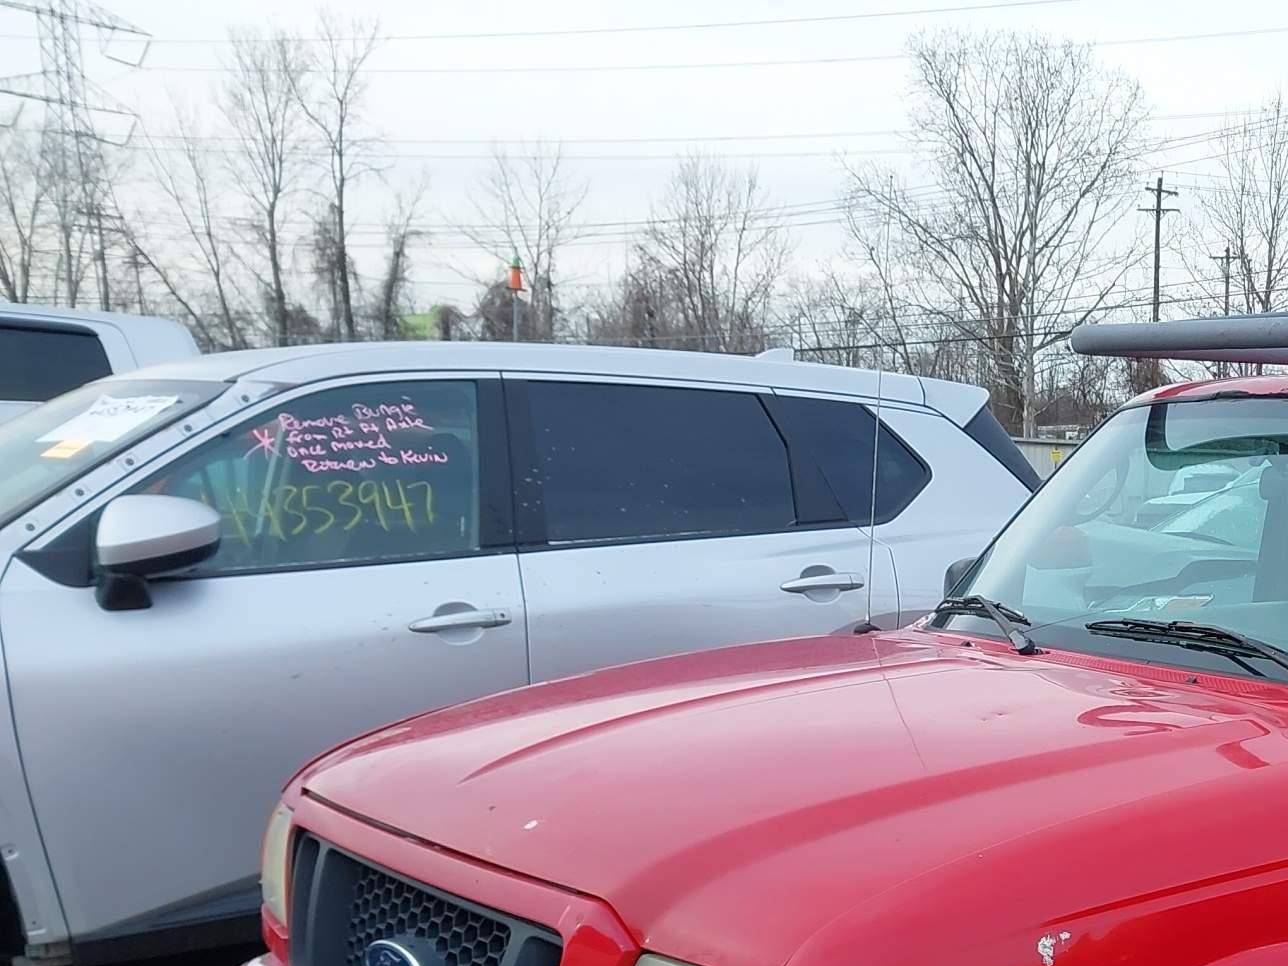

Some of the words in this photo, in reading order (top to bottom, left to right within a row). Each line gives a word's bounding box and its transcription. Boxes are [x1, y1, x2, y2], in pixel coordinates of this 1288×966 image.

[279, 413, 350, 431] Remove
[286, 430, 328, 444] from
[331, 436, 391, 451] moved
[379, 451, 399, 464] to
[400, 446, 448, 464] Kevin
